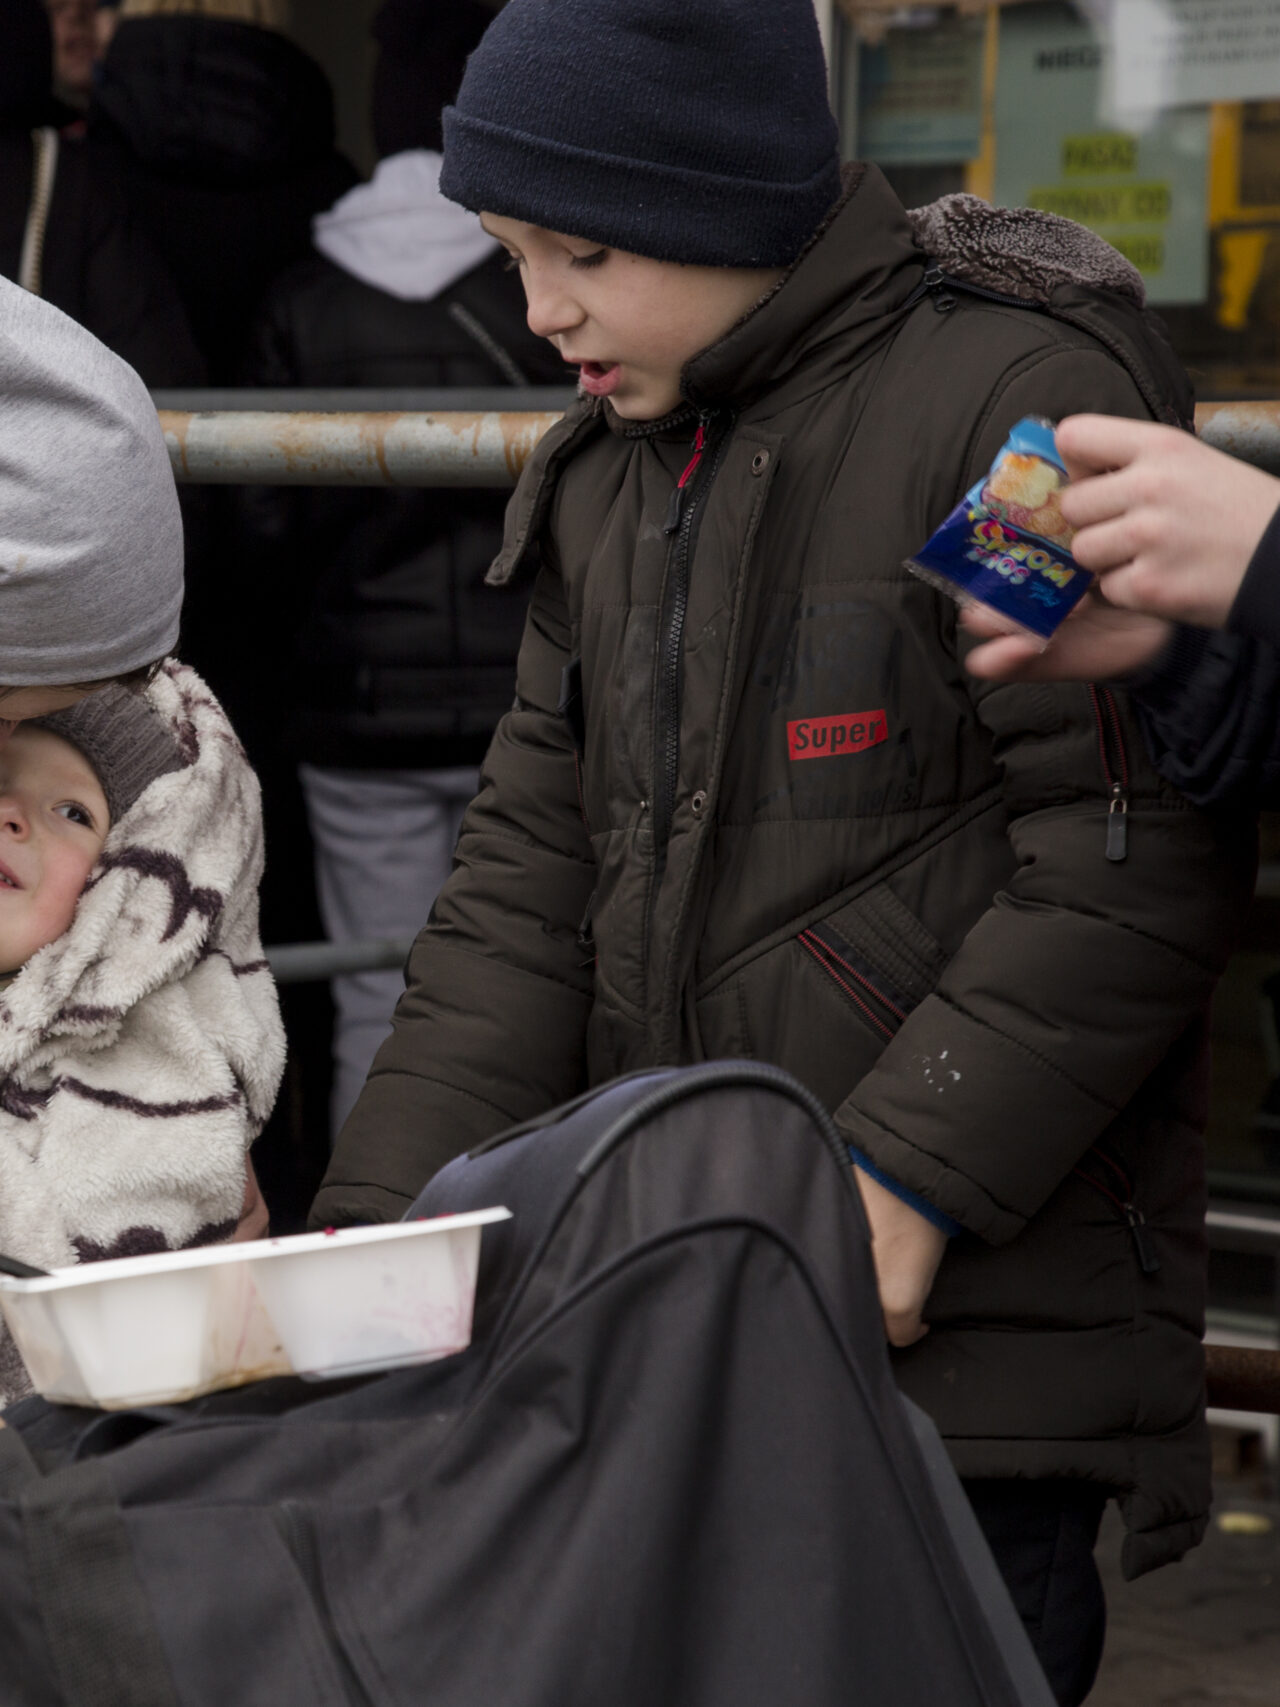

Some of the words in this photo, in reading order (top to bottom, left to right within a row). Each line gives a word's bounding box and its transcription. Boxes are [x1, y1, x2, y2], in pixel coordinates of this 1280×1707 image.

[967, 546, 1030, 585] SOUR
[970, 521, 1076, 588] WORMS
[794, 719, 882, 753] Super
